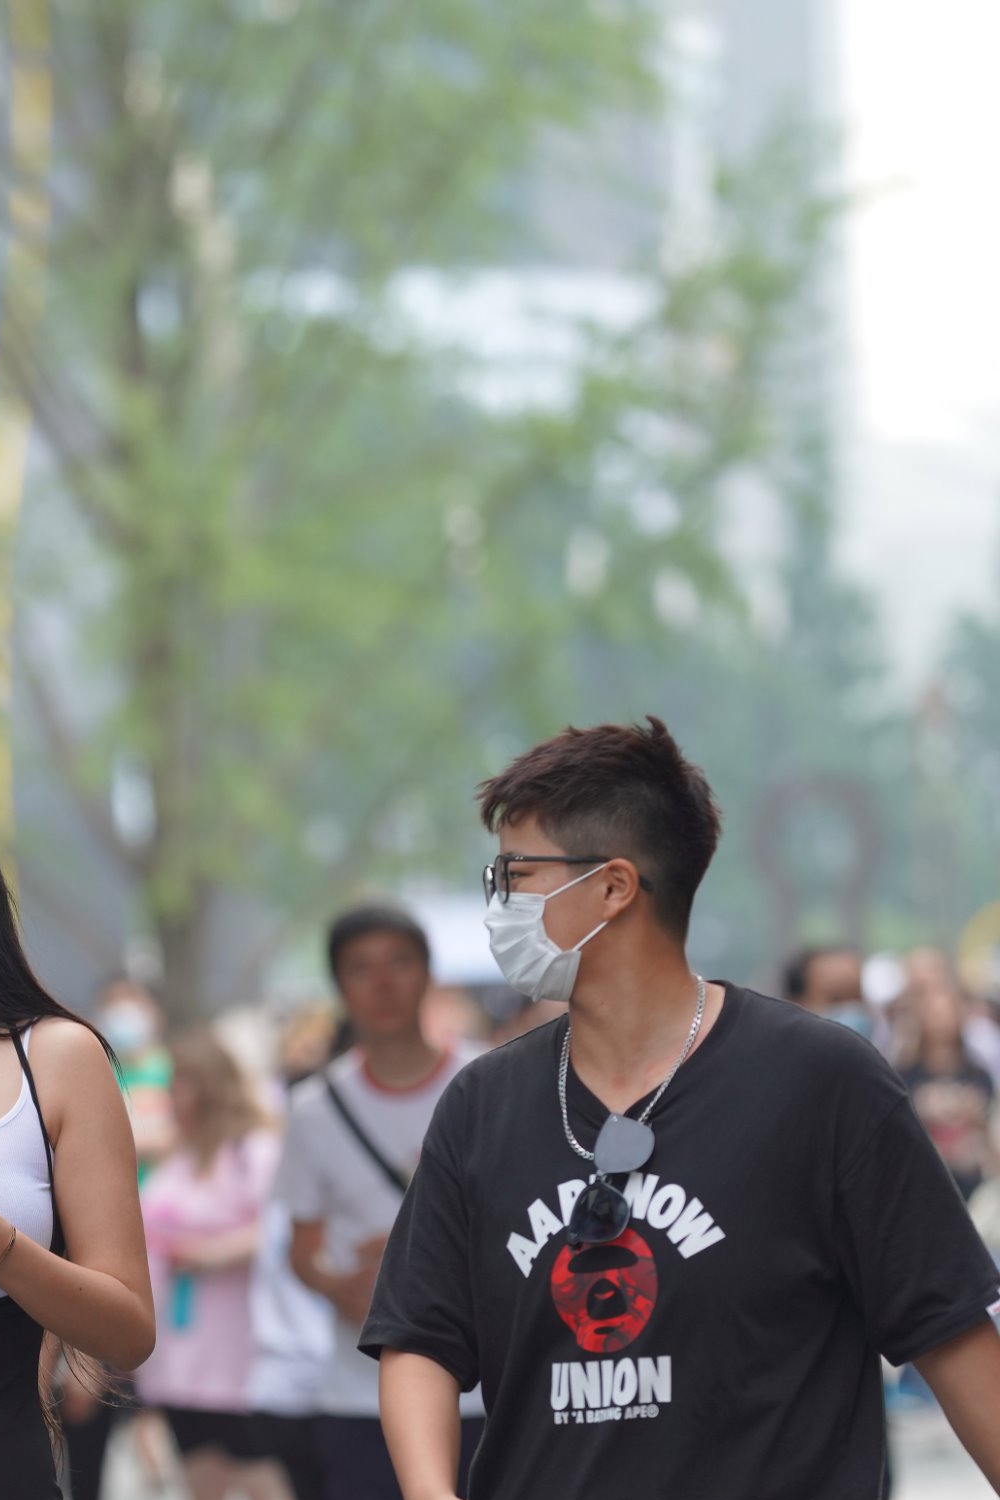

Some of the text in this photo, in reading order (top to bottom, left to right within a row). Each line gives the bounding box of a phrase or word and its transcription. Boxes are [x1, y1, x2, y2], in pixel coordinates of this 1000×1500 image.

[506, 1172, 726, 1278] AAP NOW
[551, 1356, 671, 1410] UNION
[554, 1411, 569, 1425] BY
